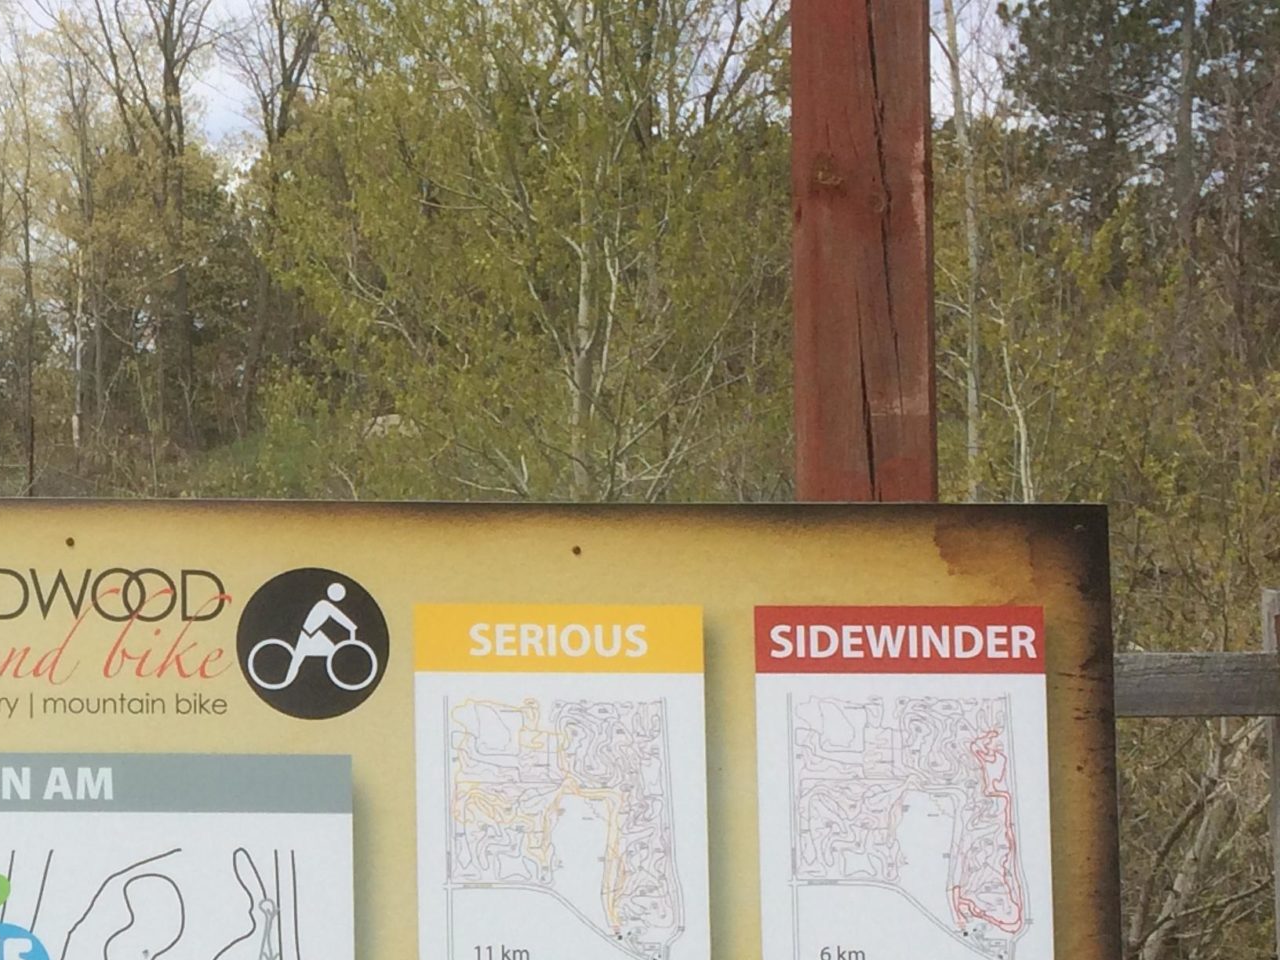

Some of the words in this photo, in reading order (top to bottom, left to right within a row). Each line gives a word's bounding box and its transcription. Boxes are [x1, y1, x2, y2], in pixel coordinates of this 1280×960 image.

[102, 588, 234, 681] bike
[469, 622, 648, 657] SERIOUS
[769, 625, 1036, 659] SIDEWINDER
[43, 692, 168, 716] mountain
[175, 692, 228, 716] bike
[42, 767, 114, 801] AM
